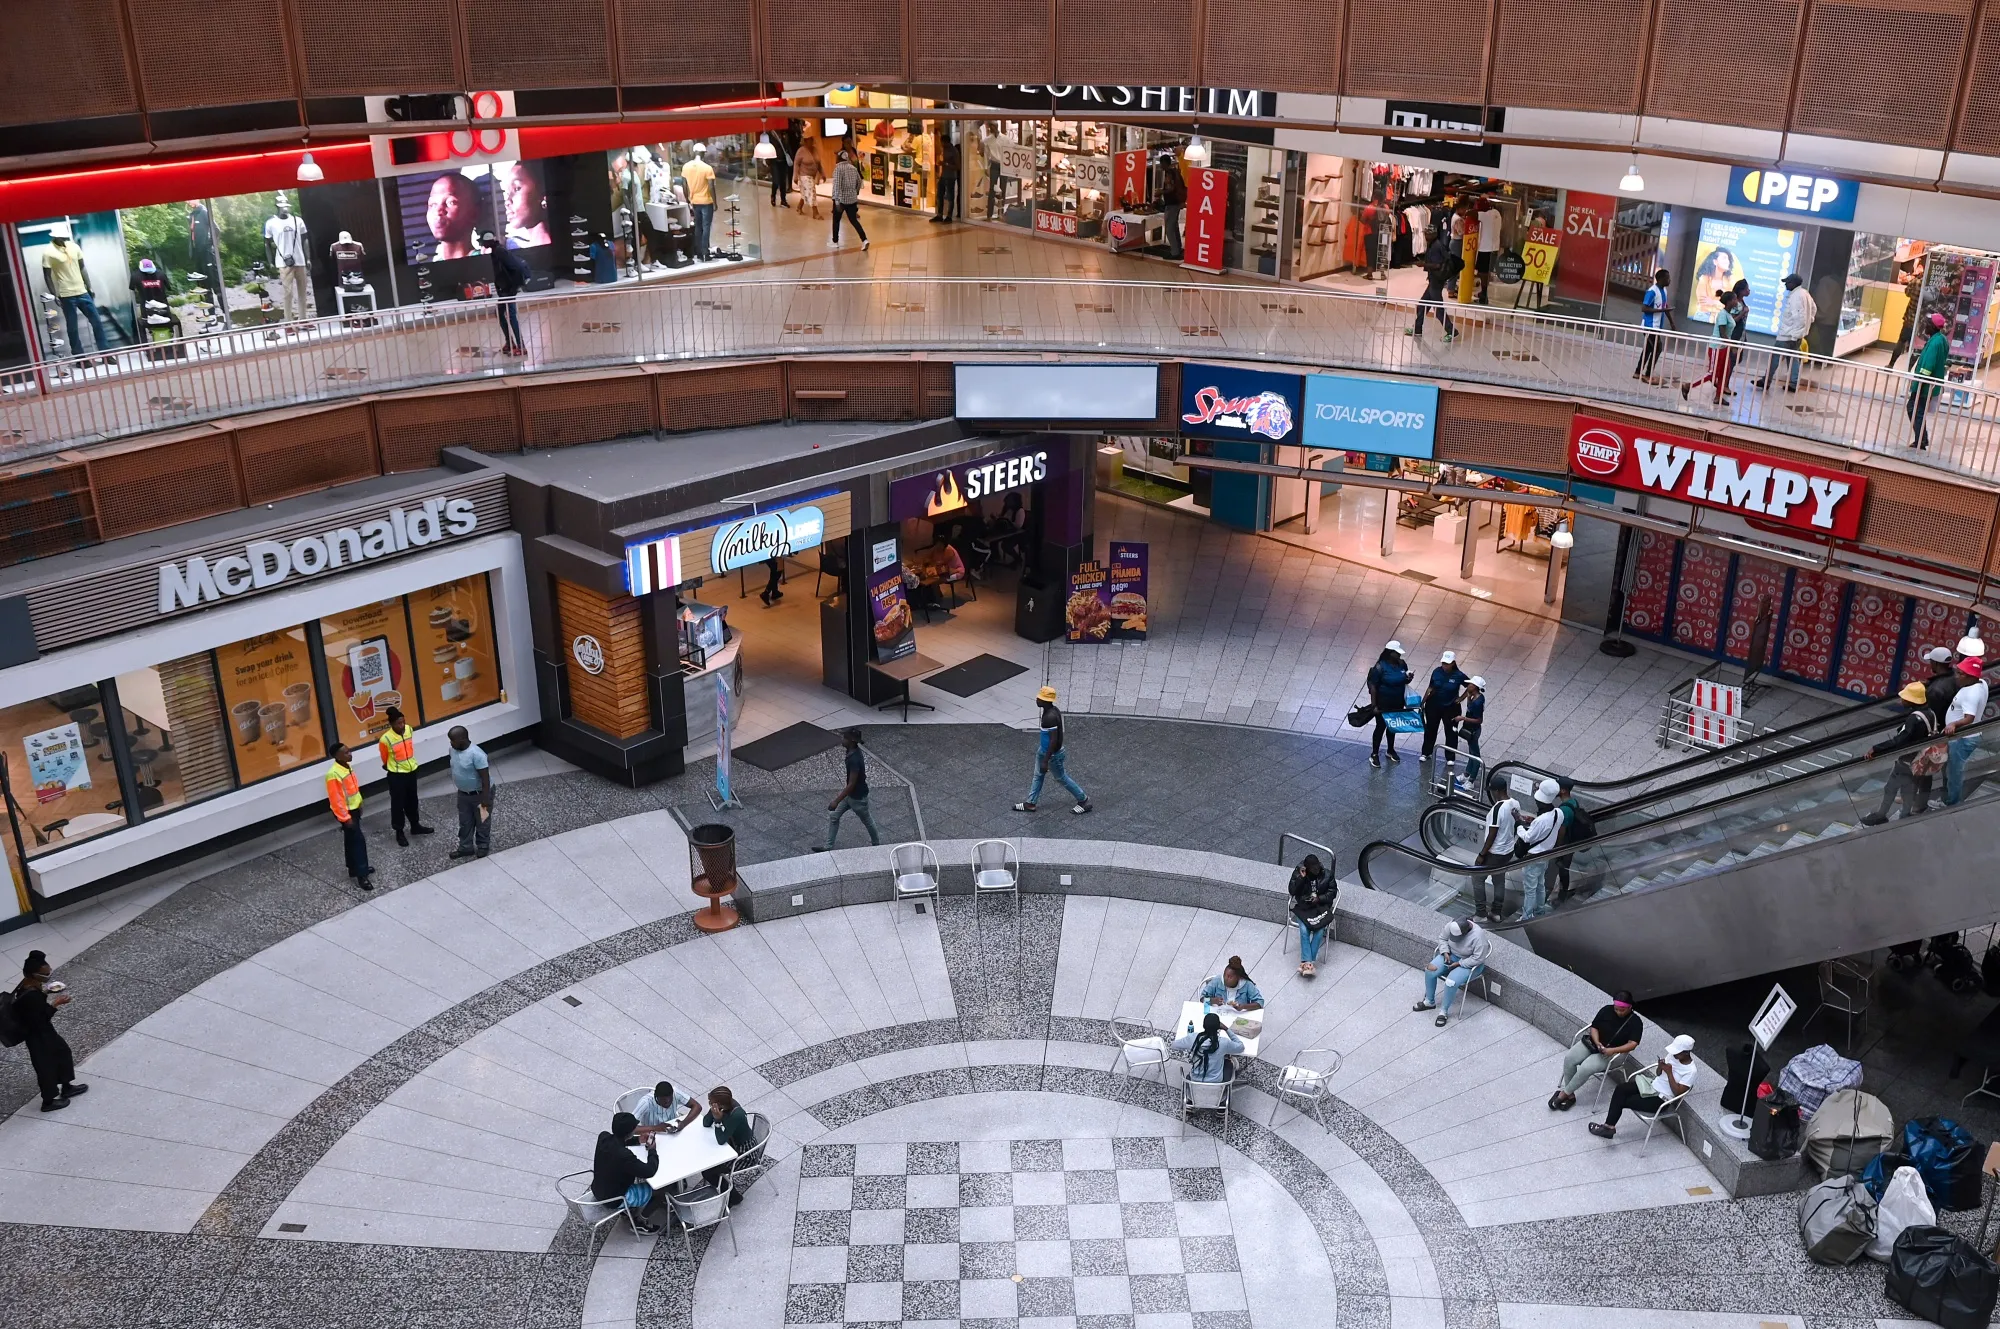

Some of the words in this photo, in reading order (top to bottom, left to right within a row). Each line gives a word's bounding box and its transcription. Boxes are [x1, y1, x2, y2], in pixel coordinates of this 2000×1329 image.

[997, 84, 1262, 117] RSHEIM
[1002, 150, 1032, 171] 30%
[1760, 171, 1839, 212] PEP
[1197, 170, 1215, 263] SALE
[1570, 205, 1581, 214] THE
[1581, 207, 1596, 216] REAL
[1037, 213, 1050, 229] SALE
[1049, 215, 1062, 231] SALE
[1063, 218, 1076, 234] SALE
[1530, 230, 1557, 245] SALE
[1535, 269, 1550, 278] OFF
[1931, 270, 1953, 278] SMART
[1928, 280, 1951, 289] SMART
[1182, 386, 1261, 424] Spur
[1315, 403, 1425, 430] TOTALSPORTS
[1578, 441, 1621, 463] WIMPY
[966, 451, 1048, 499] STEERS
[1634, 438, 1851, 529] WIMPY
[158, 496, 478, 614] McDonald's
[1071, 571, 1107, 585] CHICKEN
[1080, 562, 1099, 573] FULL
[1111, 567, 1142, 579] PHANDA
[878, 574, 902, 594] CHICKEN
[342, 608, 384, 628] Download
[235, 664, 256, 676] Swap
[256, 658, 273, 672] your
[274, 651, 295, 664] drink
[236, 678, 247, 687] for
[274, 662, 300, 677] Coffee
[1385, 718, 1420, 729] Telkom
